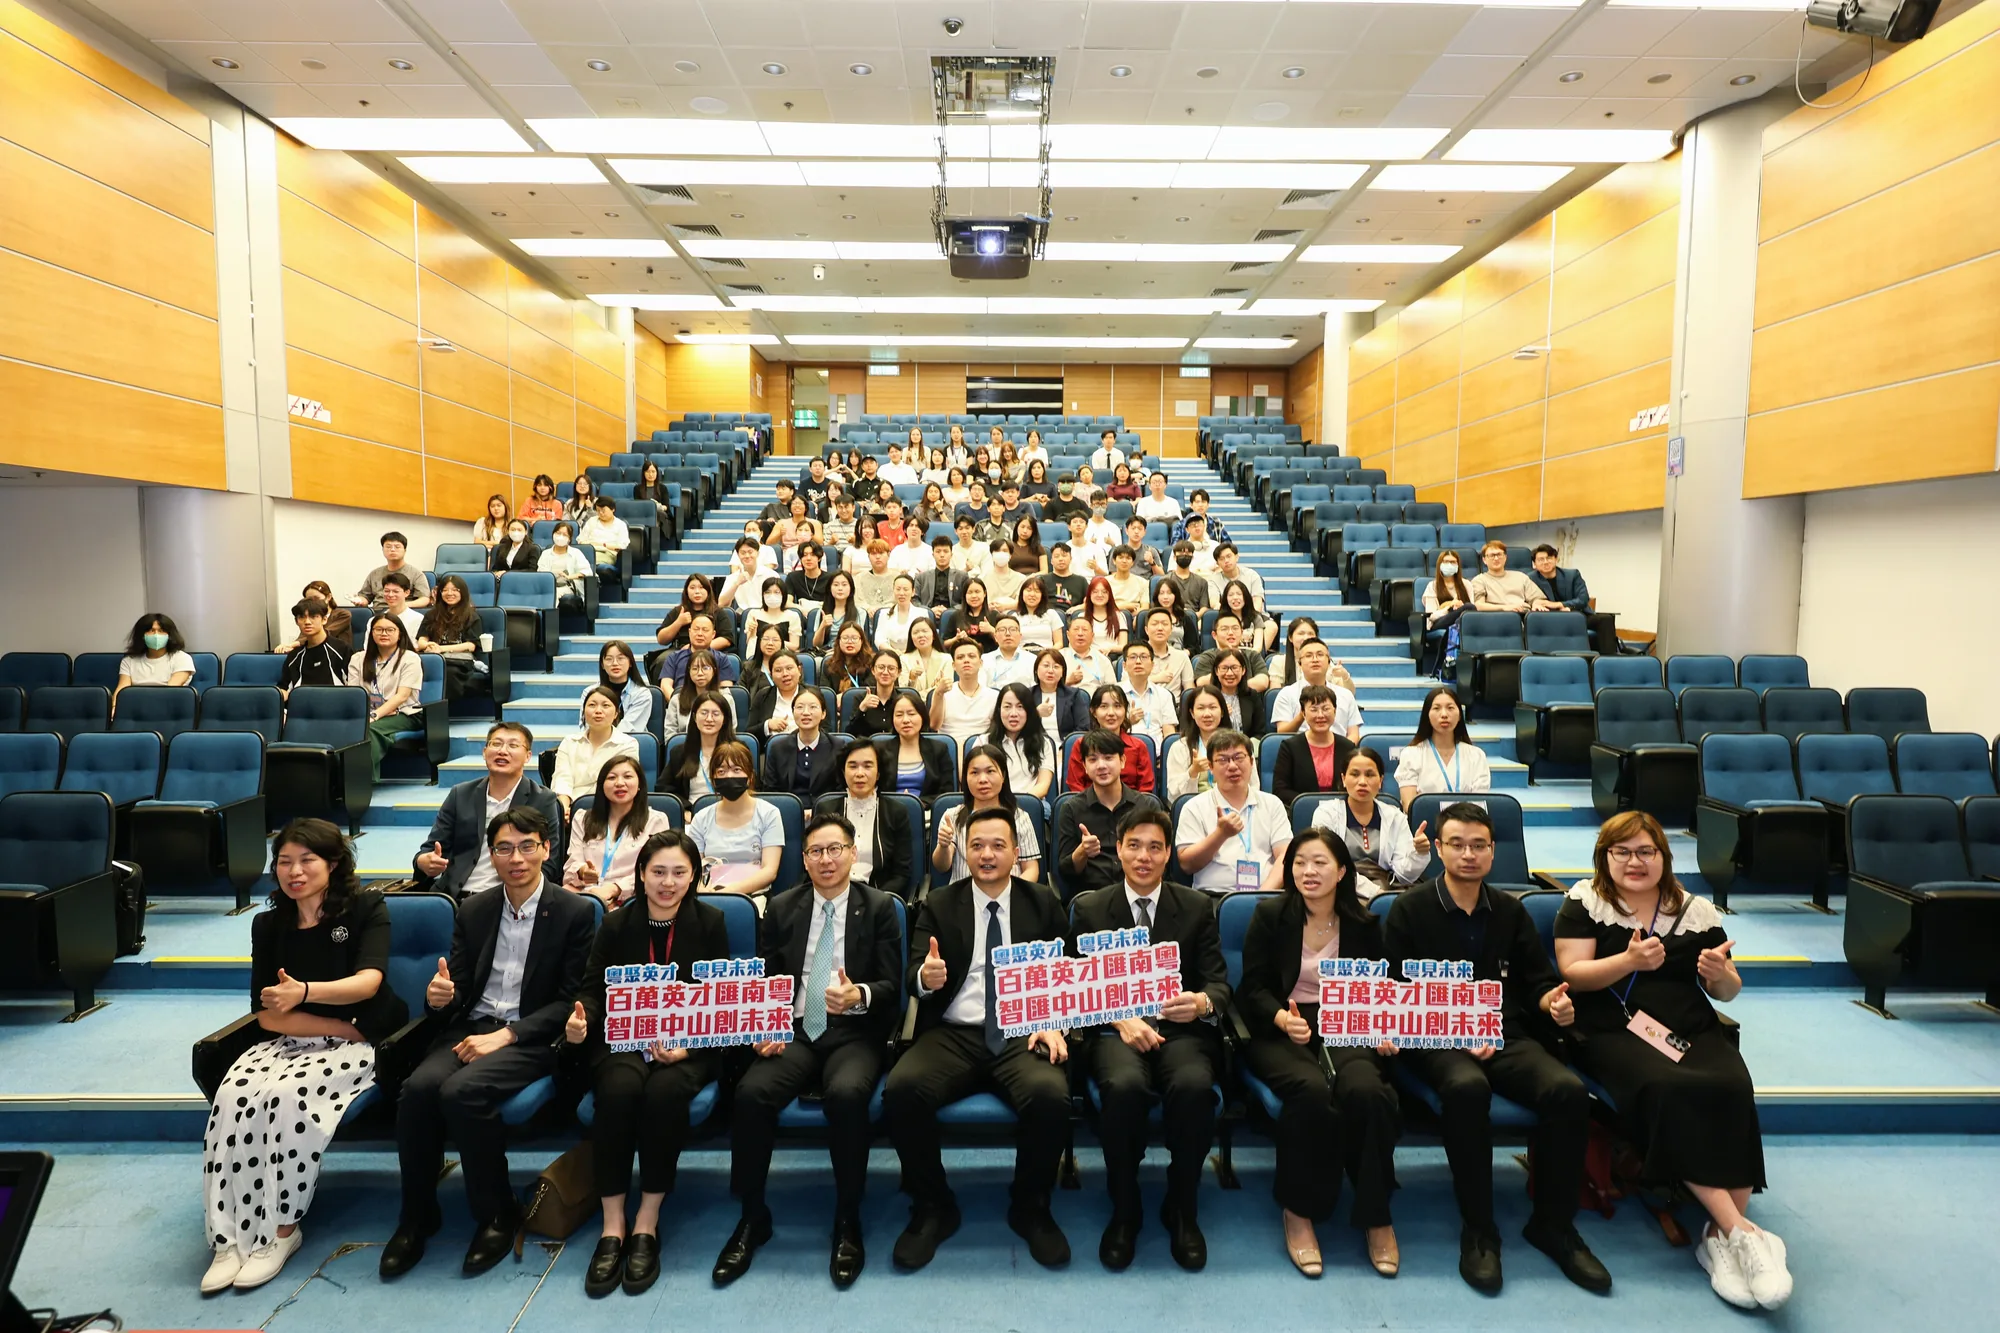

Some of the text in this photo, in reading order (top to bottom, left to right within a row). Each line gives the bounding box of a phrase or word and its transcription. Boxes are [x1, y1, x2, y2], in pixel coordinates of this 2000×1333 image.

[1079, 928, 1149, 953] 粵見未來
[607, 959, 764, 984] 粵聚英才 粵見未來
[997, 943, 1179, 996] 百萬英才匯南粵
[1320, 960, 1473, 979] 粵聚英才 粵見未來
[608, 978, 792, 1013] 百萬英才匯南粵
[999, 975, 1180, 1027] 智匯中山創未來
[1321, 980, 1501, 1007] 百萬英才匯南粵
[607, 1007, 792, 1041] 智匯中山創未來
[1321, 1010, 1501, 1037] 智匯中山創未來
